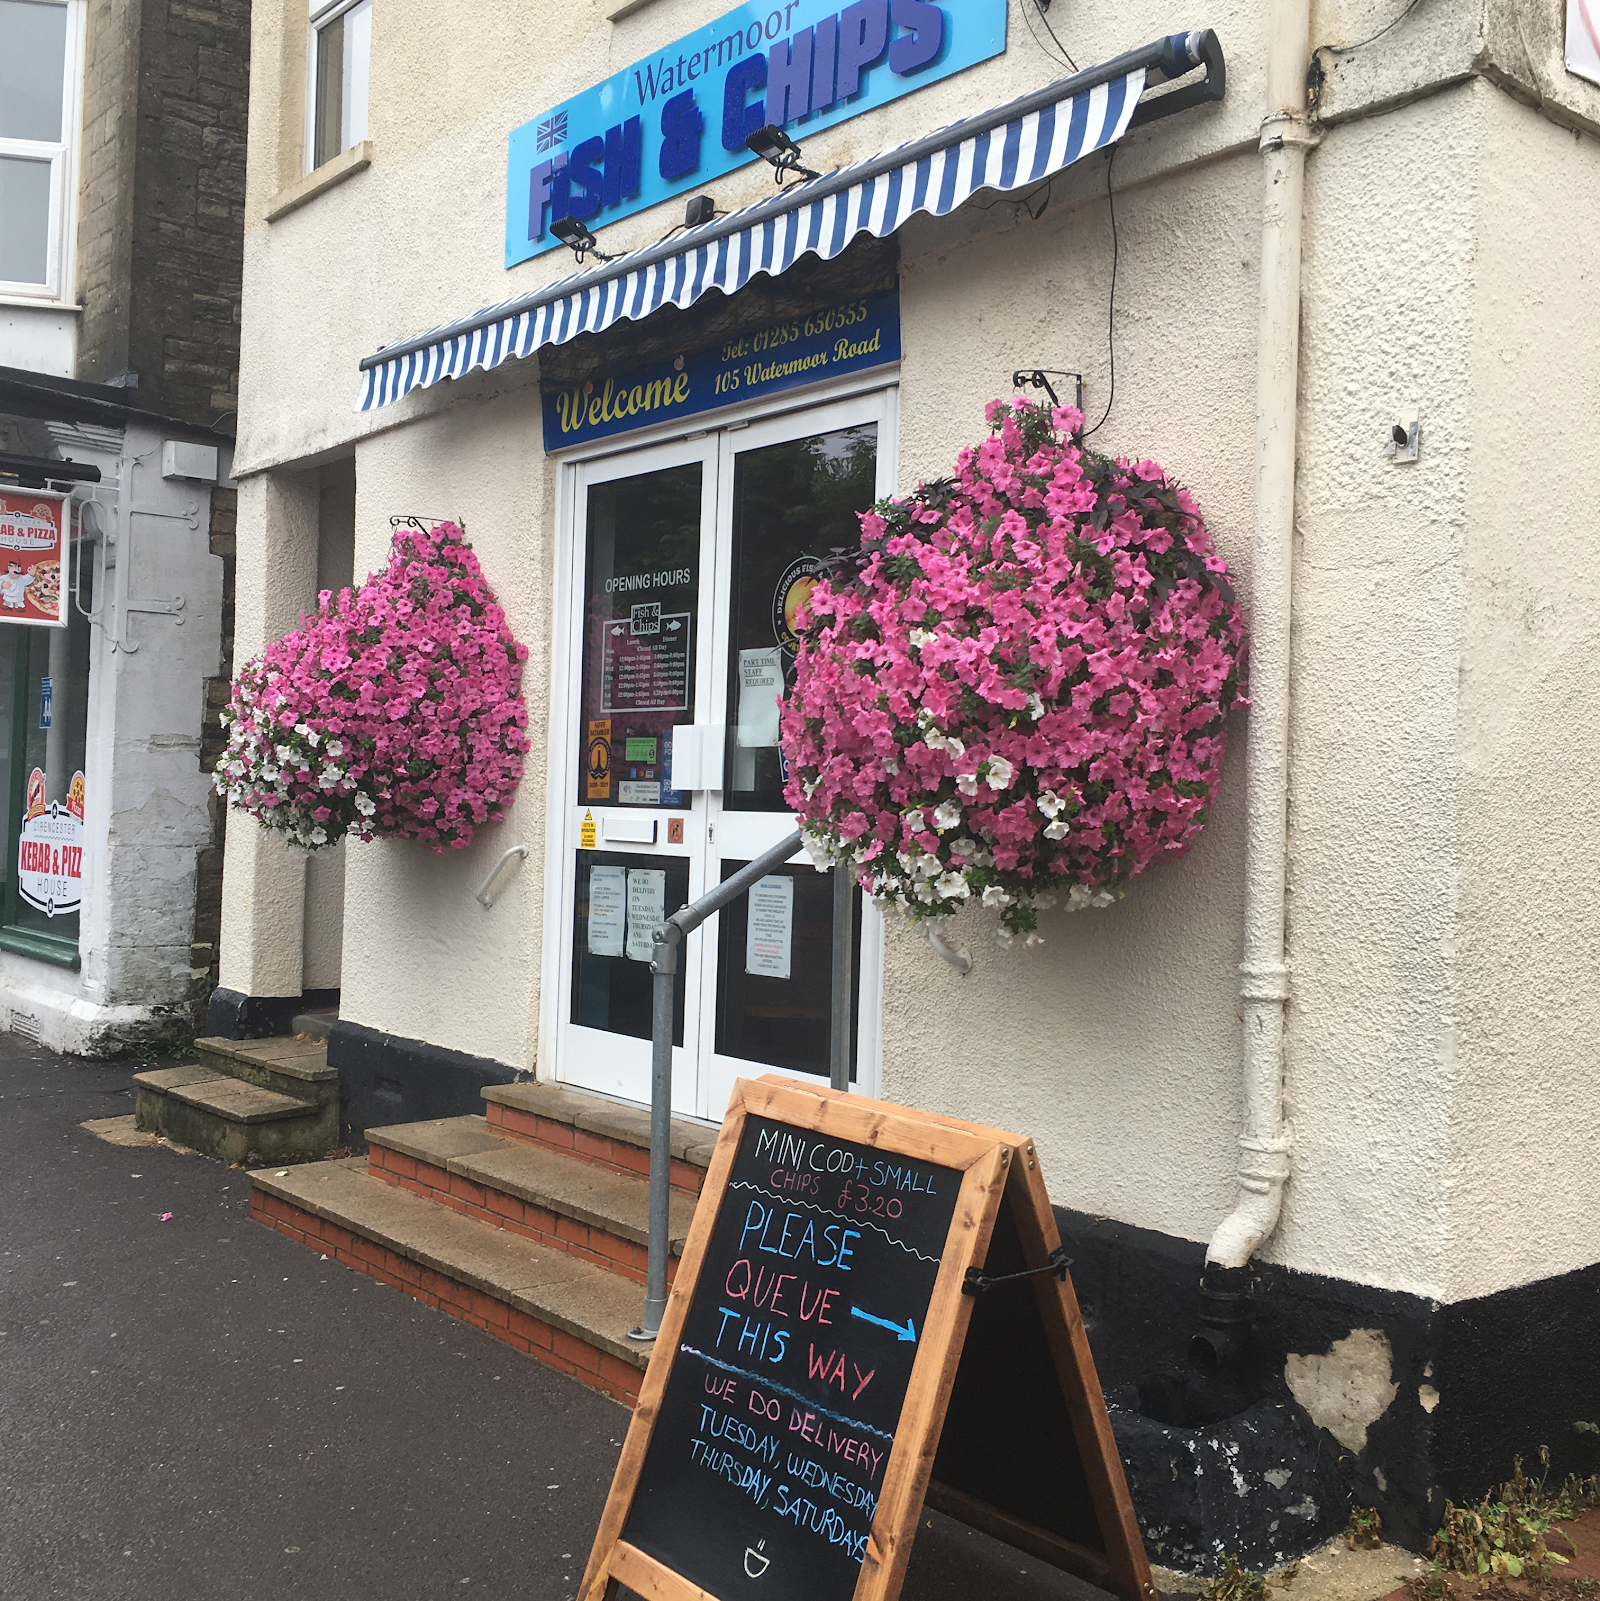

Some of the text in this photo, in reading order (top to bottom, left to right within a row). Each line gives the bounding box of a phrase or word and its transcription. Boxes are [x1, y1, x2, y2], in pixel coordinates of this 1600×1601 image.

[634, 0, 800, 106] Watermoor
[528, 0, 944, 242] FISH & CHIPS
[721, 299, 868, 362] Tel: 01285 650555
[556, 329, 881, 434] Welcome 105 Watermoor Road
[0, 524, 56, 541] AB & PIZZA
[1, 536, 35, 546] HOUSE
[605, 568, 691, 593] OPENING HOURS
[777, 566, 801, 614] DELICIOUS
[801, 564, 814, 573] FIS
[632, 619, 659, 635] Chips
[633, 605, 659, 619] Fish &
[743, 658, 759, 666] PART
[744, 668, 763, 676] STAFF
[745, 677, 775, 686] REQUIRED
[650, 749, 654, 758] 5
[33, 821, 76, 835] CIRENCESTER
[20, 840, 83, 879] KEBAB & PIZZ
[36, 878, 67, 897] HOUSE
[754, 1128, 806, 1171] MINI
[809, 1143, 855, 1174] COD
[869, 1160, 937, 1195] SMALL
[770, 1169, 903, 1219] CHIPS £3.20
[738, 1200, 862, 1271] PLEASE
[725, 1259, 841, 1325] QUEUE
[716, 1306, 876, 1401] THIS WAY
[704, 1373, 884, 1481] WE DO DELIVERY
[700, 1403, 879, 1522] TUESDAY, WEDNESDAY
[691, 1438, 870, 1563] THURSDAY, SATURDAYS
